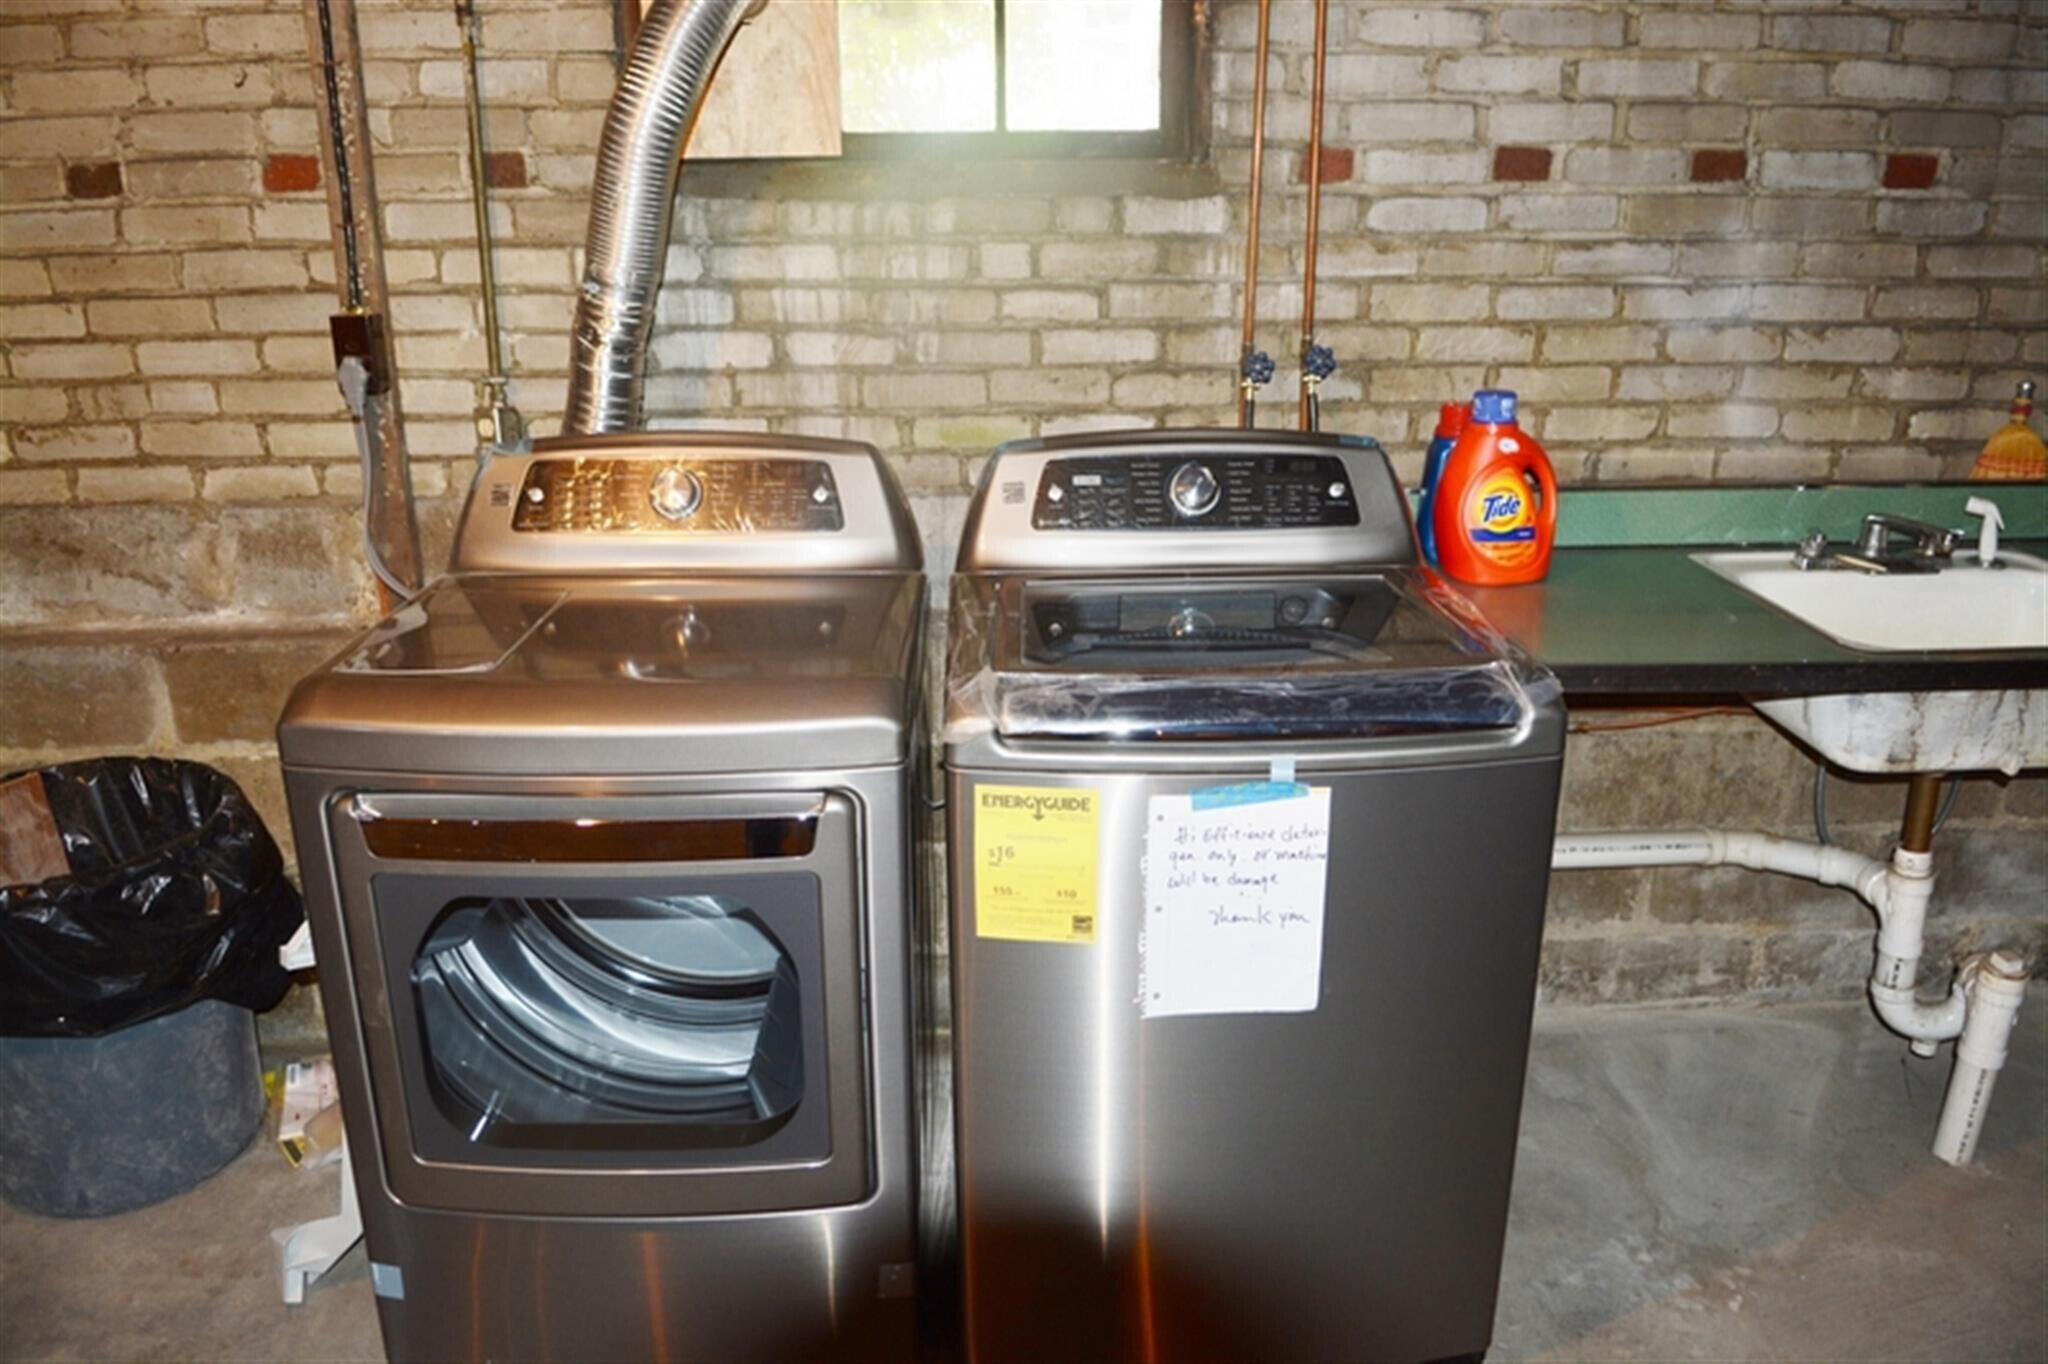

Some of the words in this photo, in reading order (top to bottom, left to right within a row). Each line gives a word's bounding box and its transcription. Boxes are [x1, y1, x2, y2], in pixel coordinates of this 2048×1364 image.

[1483, 494, 1521, 522] Tide
[981, 793, 1091, 814] ENERGYGUIDE
[1208, 849, 1238, 867] only
[1227, 871, 1279, 893] damage
[1279, 912, 1312, 929] you
